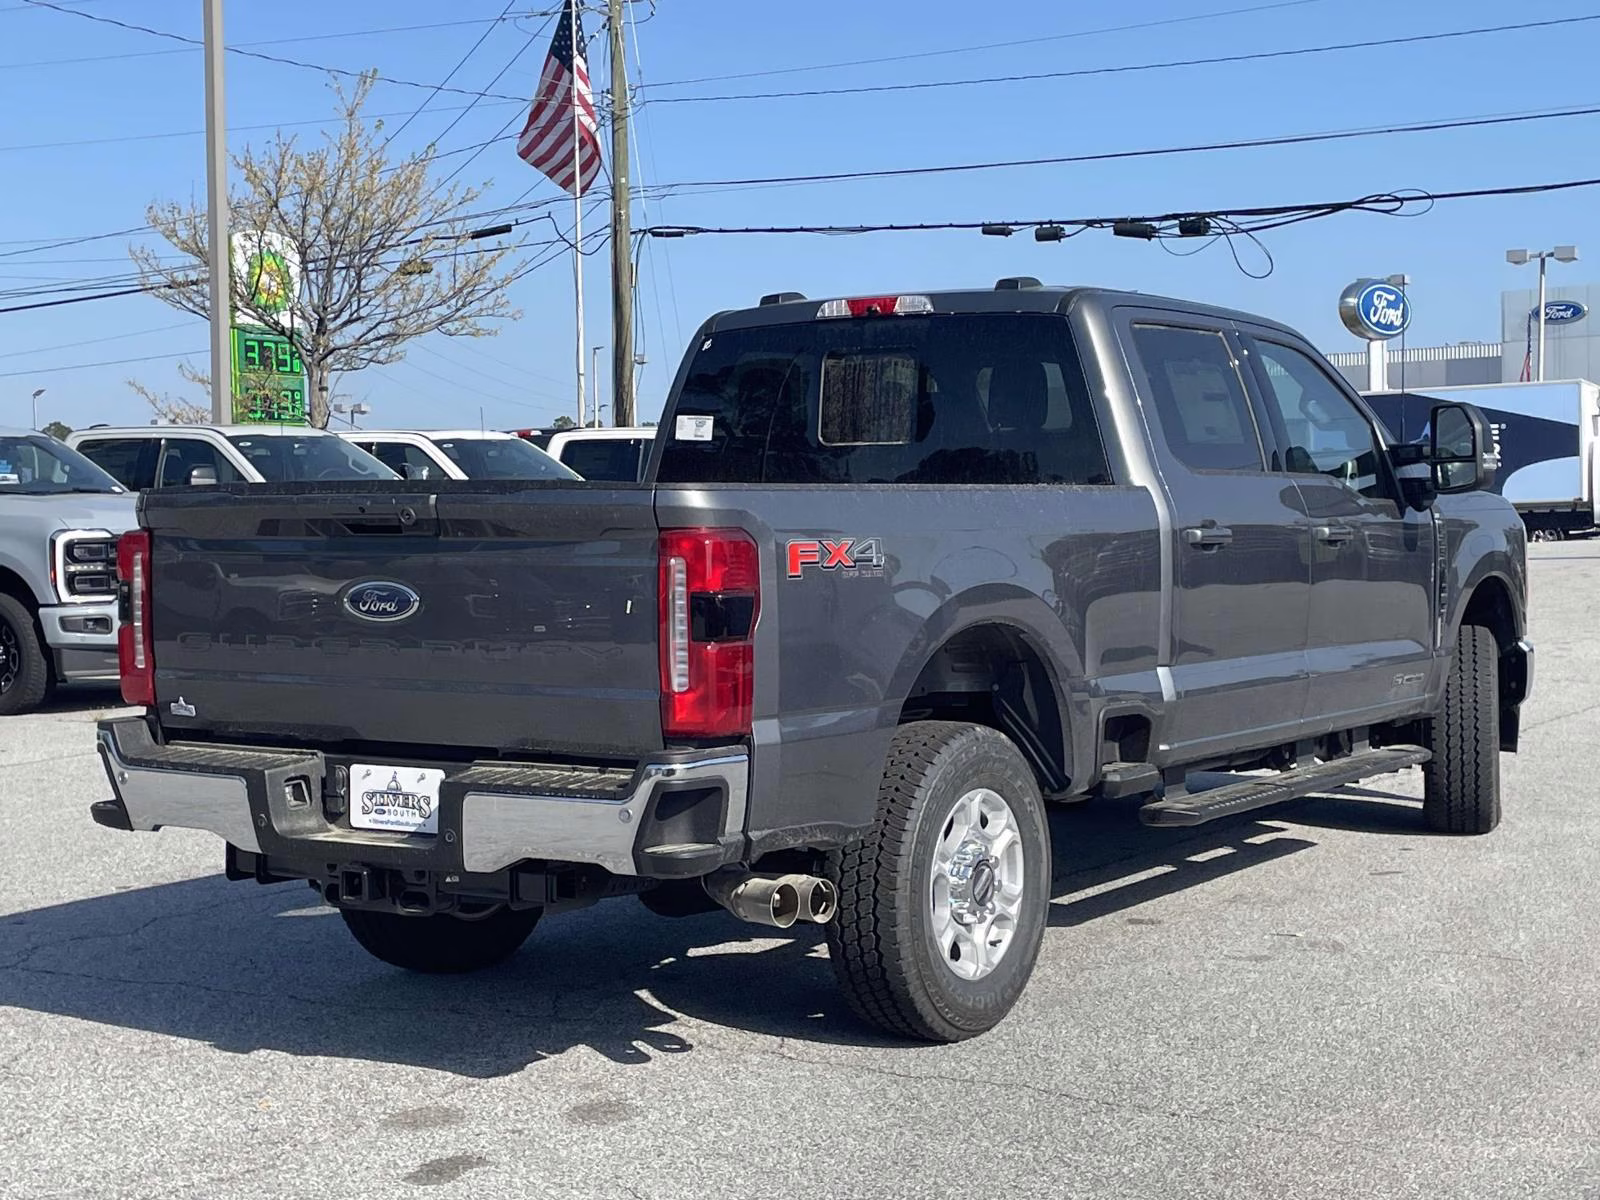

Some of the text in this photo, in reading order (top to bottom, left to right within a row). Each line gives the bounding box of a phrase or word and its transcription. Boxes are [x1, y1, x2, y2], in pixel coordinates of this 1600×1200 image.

[1370, 290, 1404, 326] Ford
[1544, 305, 1573, 319] Ford
[785, 537, 884, 580] FX4
[360, 589, 399, 612] Ford
[361, 791, 431, 819] STIVERS
[387, 808, 418, 818] SOUTH
